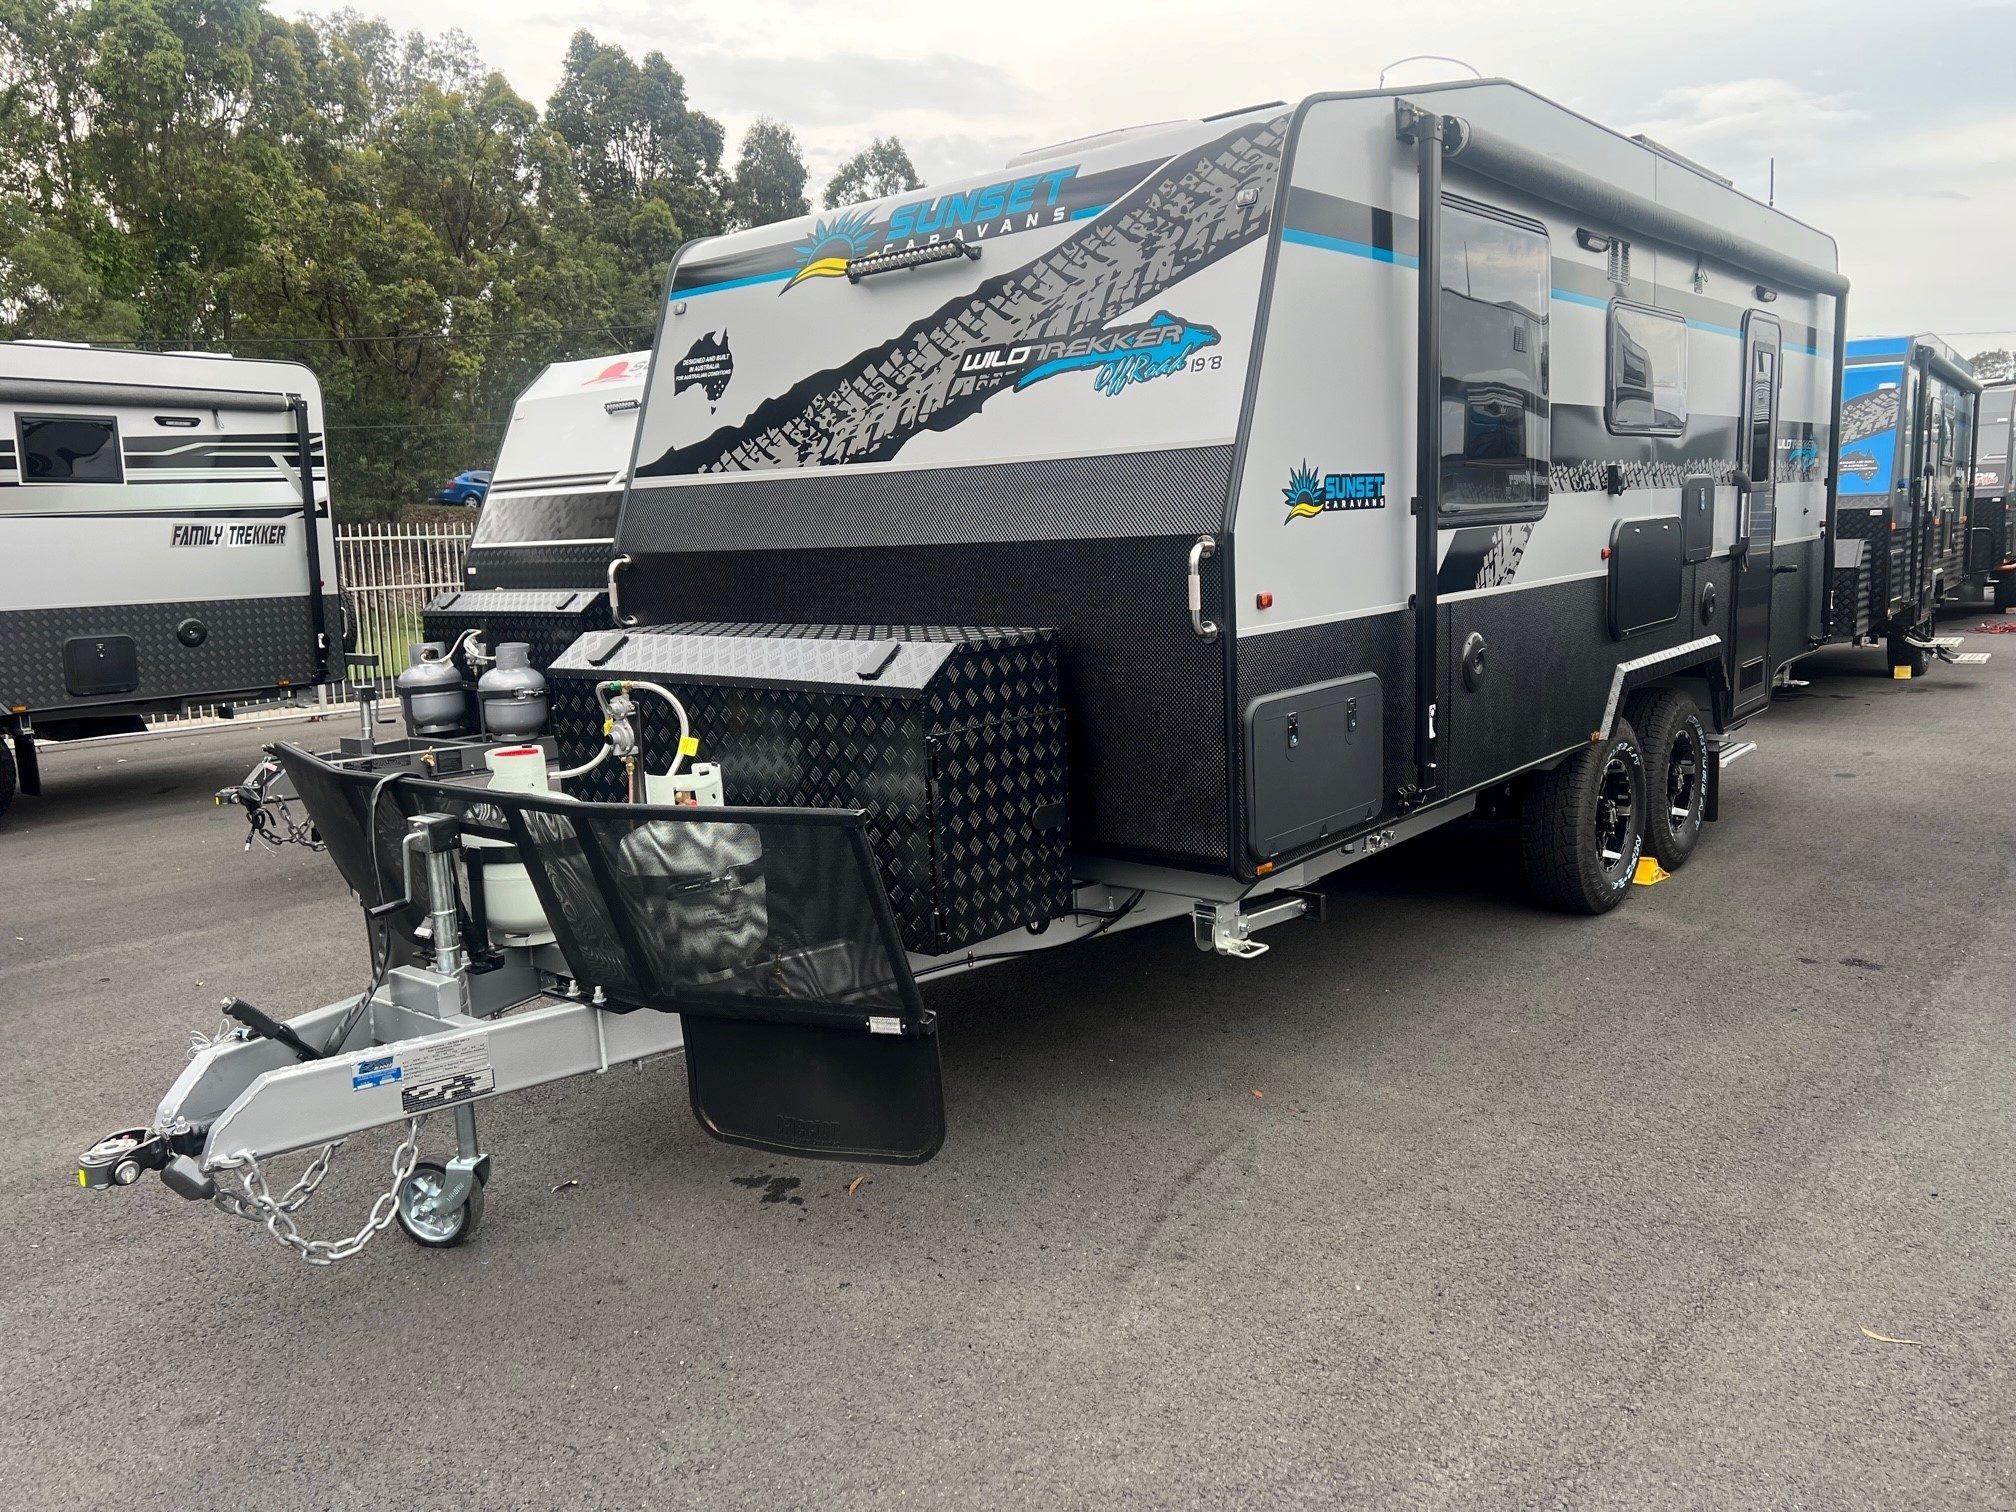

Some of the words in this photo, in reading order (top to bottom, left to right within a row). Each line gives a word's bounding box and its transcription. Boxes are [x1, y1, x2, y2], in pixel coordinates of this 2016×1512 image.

[885, 165, 1080, 241] SUNSET
[682, 357, 705, 366] DESIGNED
[716, 353, 730, 361] BUILT
[694, 363, 720, 371] AUSTRALIA
[684, 372, 708, 380] AUSTRALIAN
[707, 369, 732, 377] CONDITIONS
[1325, 476, 1384, 499] SUNSET
[1325, 498, 1384, 509] CARAVANS
[172, 525, 223, 546] FAMILY
[229, 525, 286, 545] TREKKER
